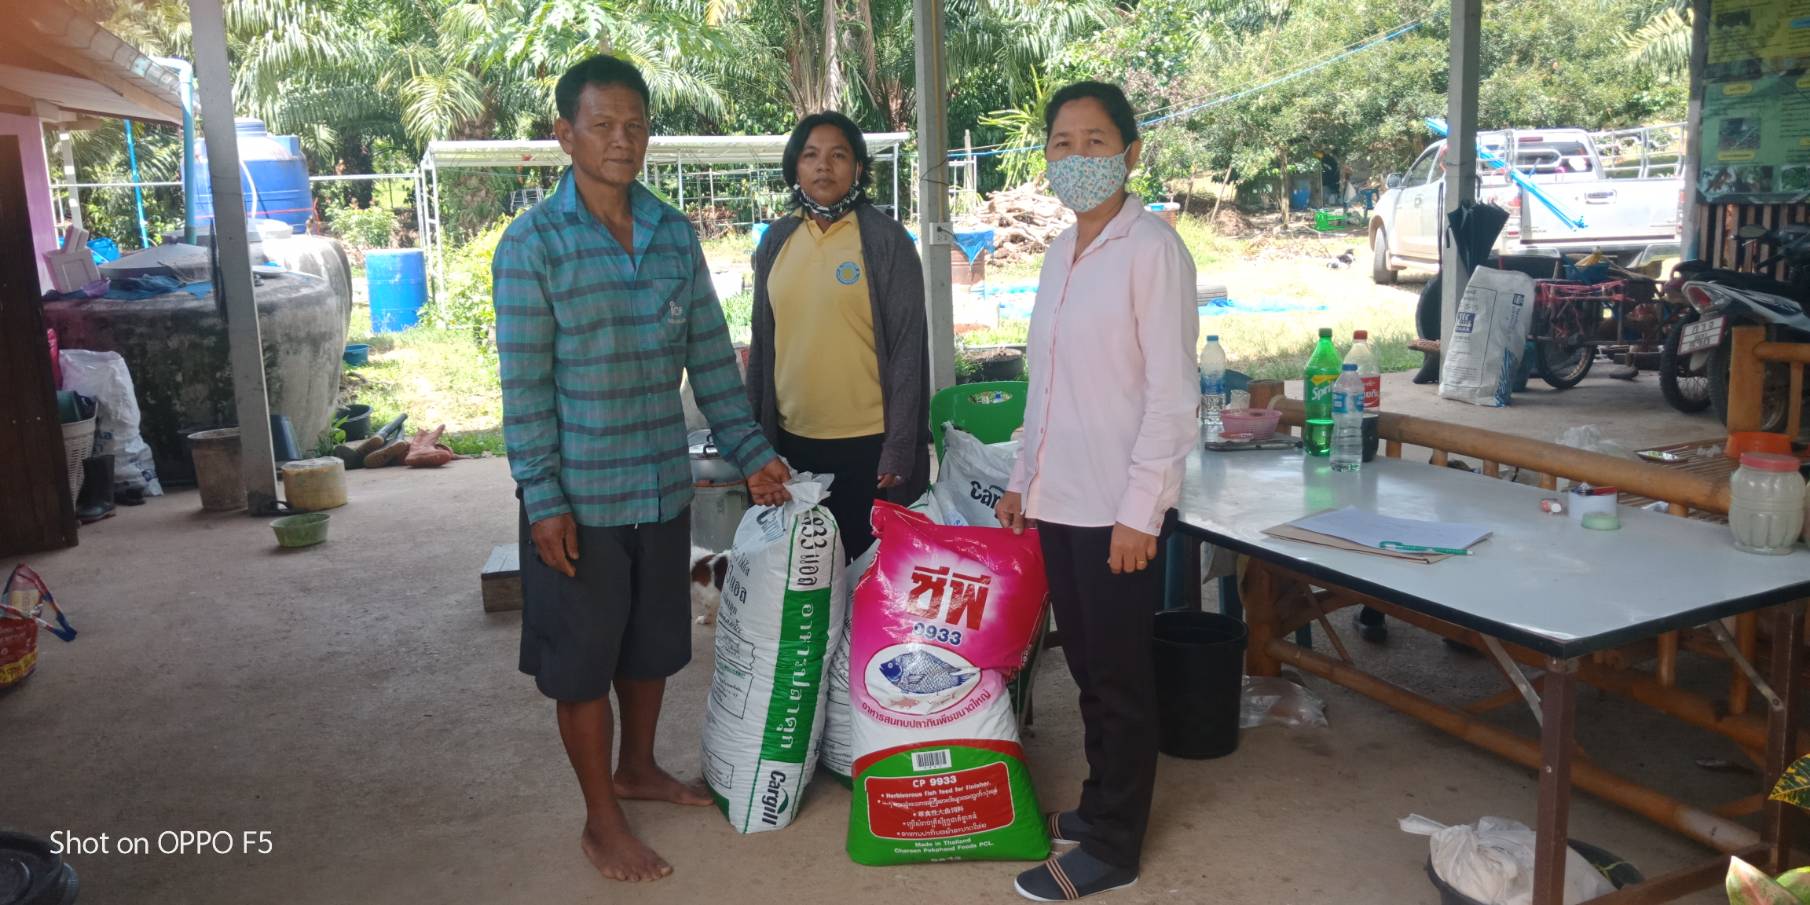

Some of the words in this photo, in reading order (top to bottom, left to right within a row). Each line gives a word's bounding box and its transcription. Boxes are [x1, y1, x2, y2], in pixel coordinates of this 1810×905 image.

[776, 604, 814, 749] อาหารปลาดุก
[761, 770, 787, 826] Cargill
[912, 779, 926, 788] CP
[929, 775, 957, 786] 9933
[943, 837, 971, 846] Thailand
